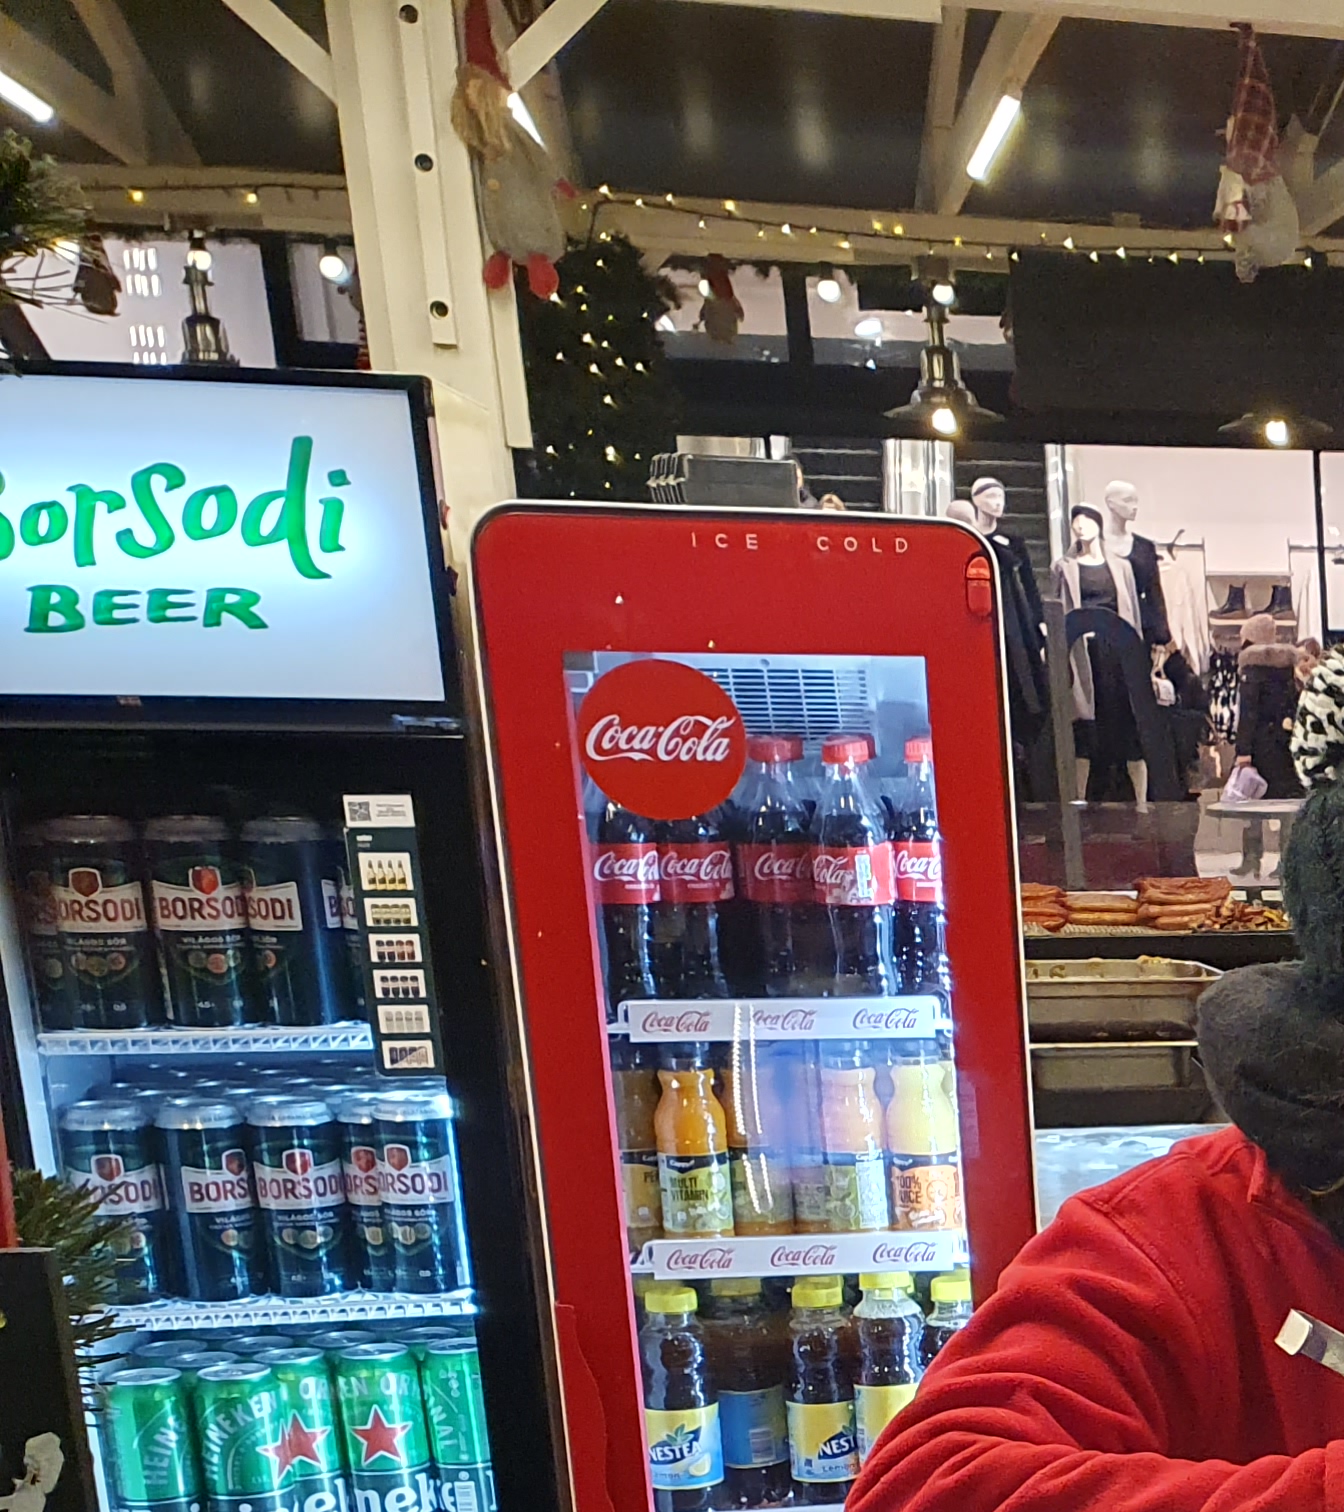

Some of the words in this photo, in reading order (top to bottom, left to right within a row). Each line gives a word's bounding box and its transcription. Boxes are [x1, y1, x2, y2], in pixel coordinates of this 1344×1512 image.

[692, 532, 759, 549] ICE
[817, 536, 910, 553] COLD
[24, 584, 269, 634] BEER
[586, 714, 736, 763] Coca-Cola
[159, 896, 245, 922] BORSO
[247, 897, 295, 921] SODI
[642, 1010, 712, 1034] Coca-Cola
[852, 1007, 920, 1031] Coca-Cola
[188, 1178, 248, 1203] BORS
[379, 1171, 448, 1195] ORSODI
[898, 1189, 923, 1205] UICE
[666, 1247, 736, 1271] Coca-Cola
[770, 1244, 839, 1268] Coca-Cola
[872, 1242, 939, 1264] Coca-Cola
[818, 1435, 856, 1457] NEST
